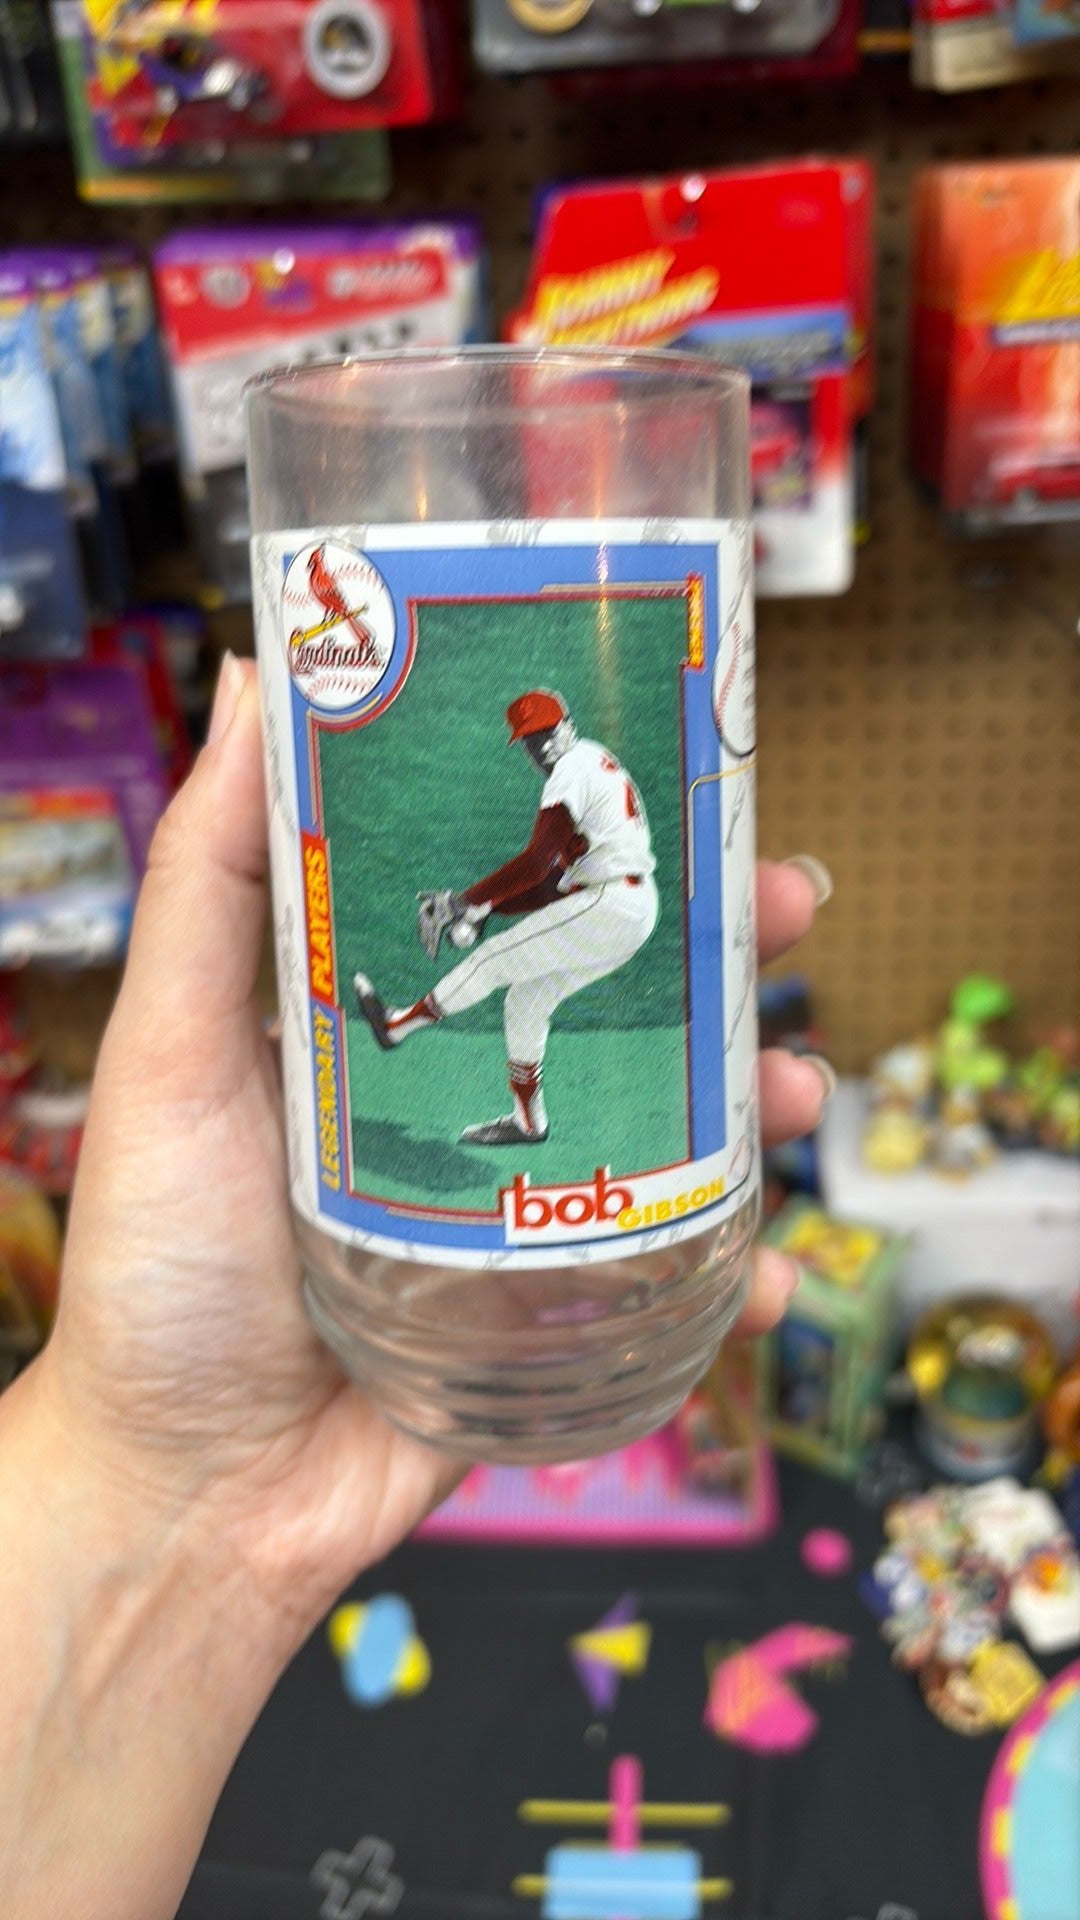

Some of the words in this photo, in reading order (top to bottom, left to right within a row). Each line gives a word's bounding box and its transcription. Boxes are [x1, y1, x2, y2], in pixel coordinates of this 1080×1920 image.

[305, 846, 333, 991] PLAYERS
[315, 1007, 341, 1191] LEGENDARY
[513, 1167, 634, 1229] bob
[617, 1177, 724, 1230] GIBSON
